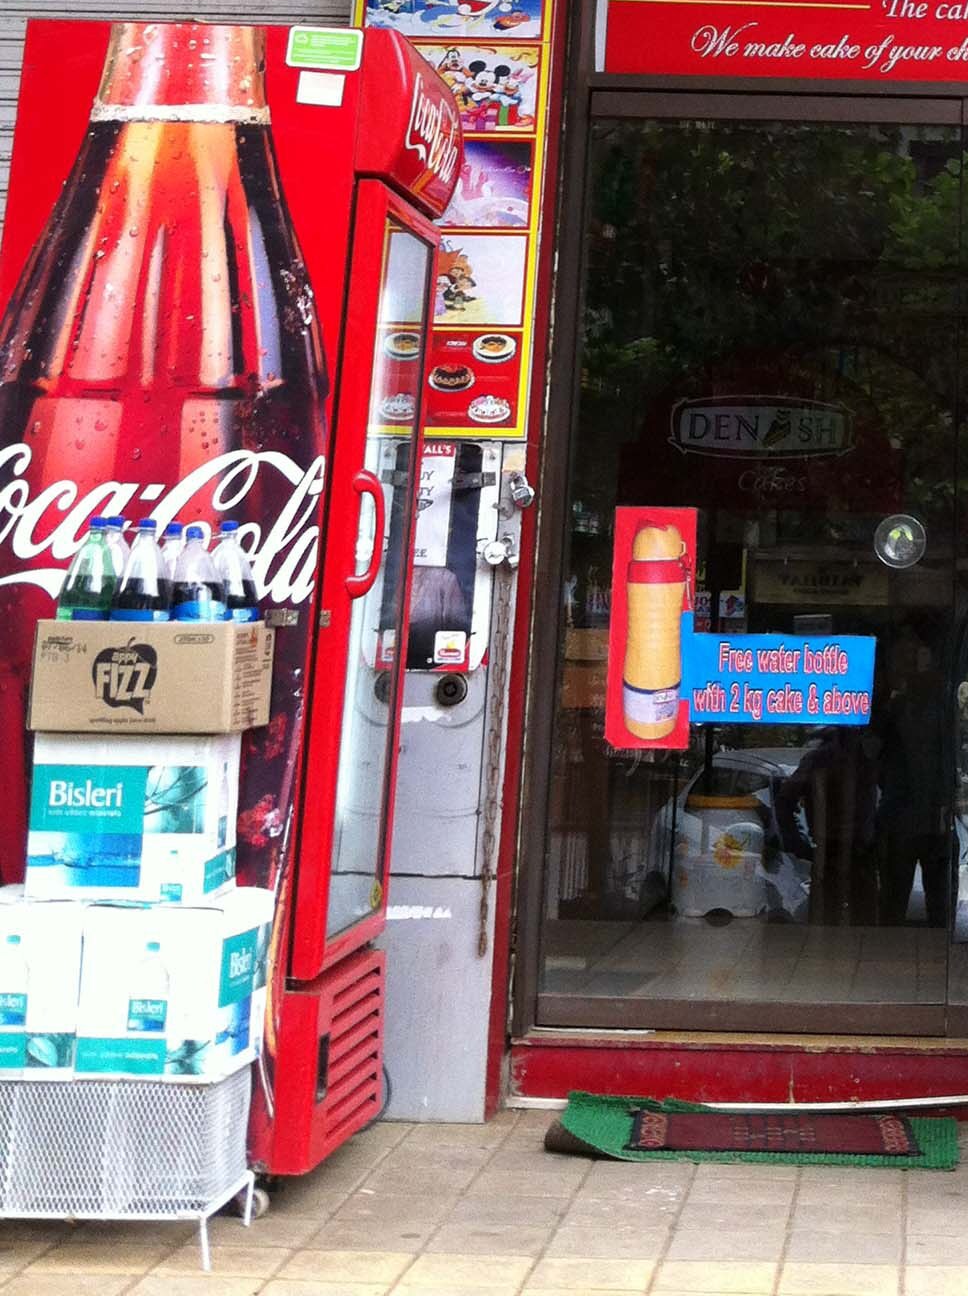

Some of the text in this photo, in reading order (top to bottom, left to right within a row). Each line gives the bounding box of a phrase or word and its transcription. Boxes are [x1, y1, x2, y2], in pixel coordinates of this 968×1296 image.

[690, 21, 758, 58] We
[743, 33, 806, 60] make
[810, 34, 860, 60] cake
[861, 34, 895, 70] of
[880, 41, 943, 73] your
[422, 444, 452, 455] ALL'S
[718, 640, 849, 675] Free water bottle
[95, 662, 152, 701] FIZZ
[693, 680, 726, 712] with
[729, 682, 740, 713] 2
[743, 682, 763, 720] kg
[766, 683, 803, 714] cake
[807, 683, 819, 715] &
[822, 686, 871, 716] above
[49, 779, 124, 808] Bisleri
